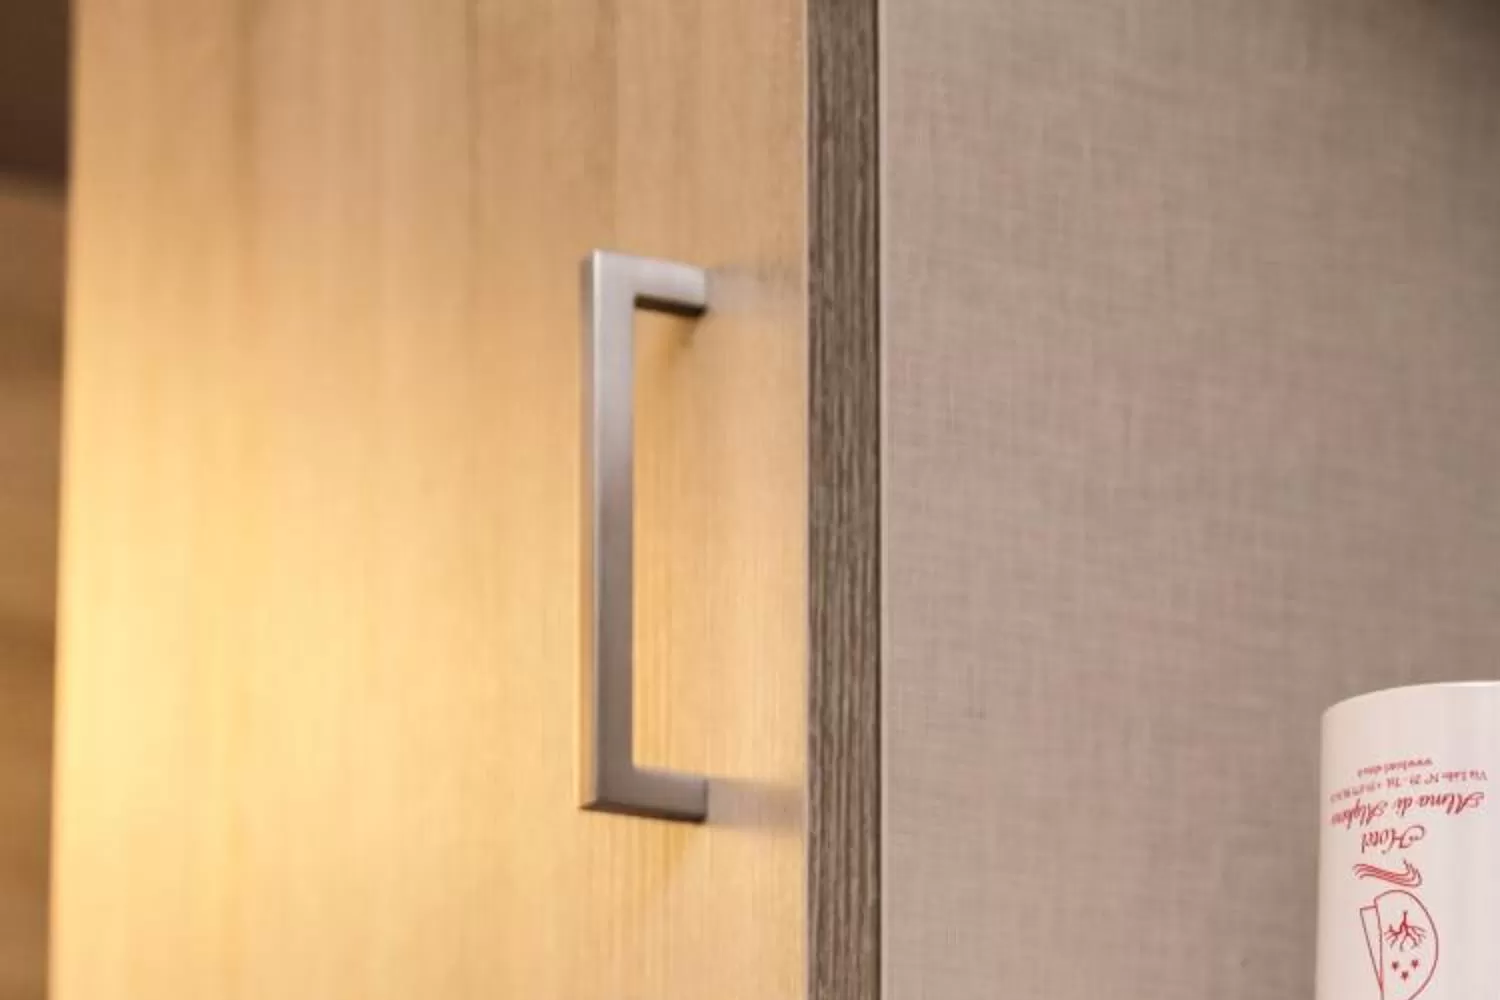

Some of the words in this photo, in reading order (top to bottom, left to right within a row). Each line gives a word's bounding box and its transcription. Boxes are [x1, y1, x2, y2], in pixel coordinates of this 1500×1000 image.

[1395, 797, 1413, 816] di
[1418, 792, 1484, 815] Alma
[1361, 825, 1425, 854] Hotel
